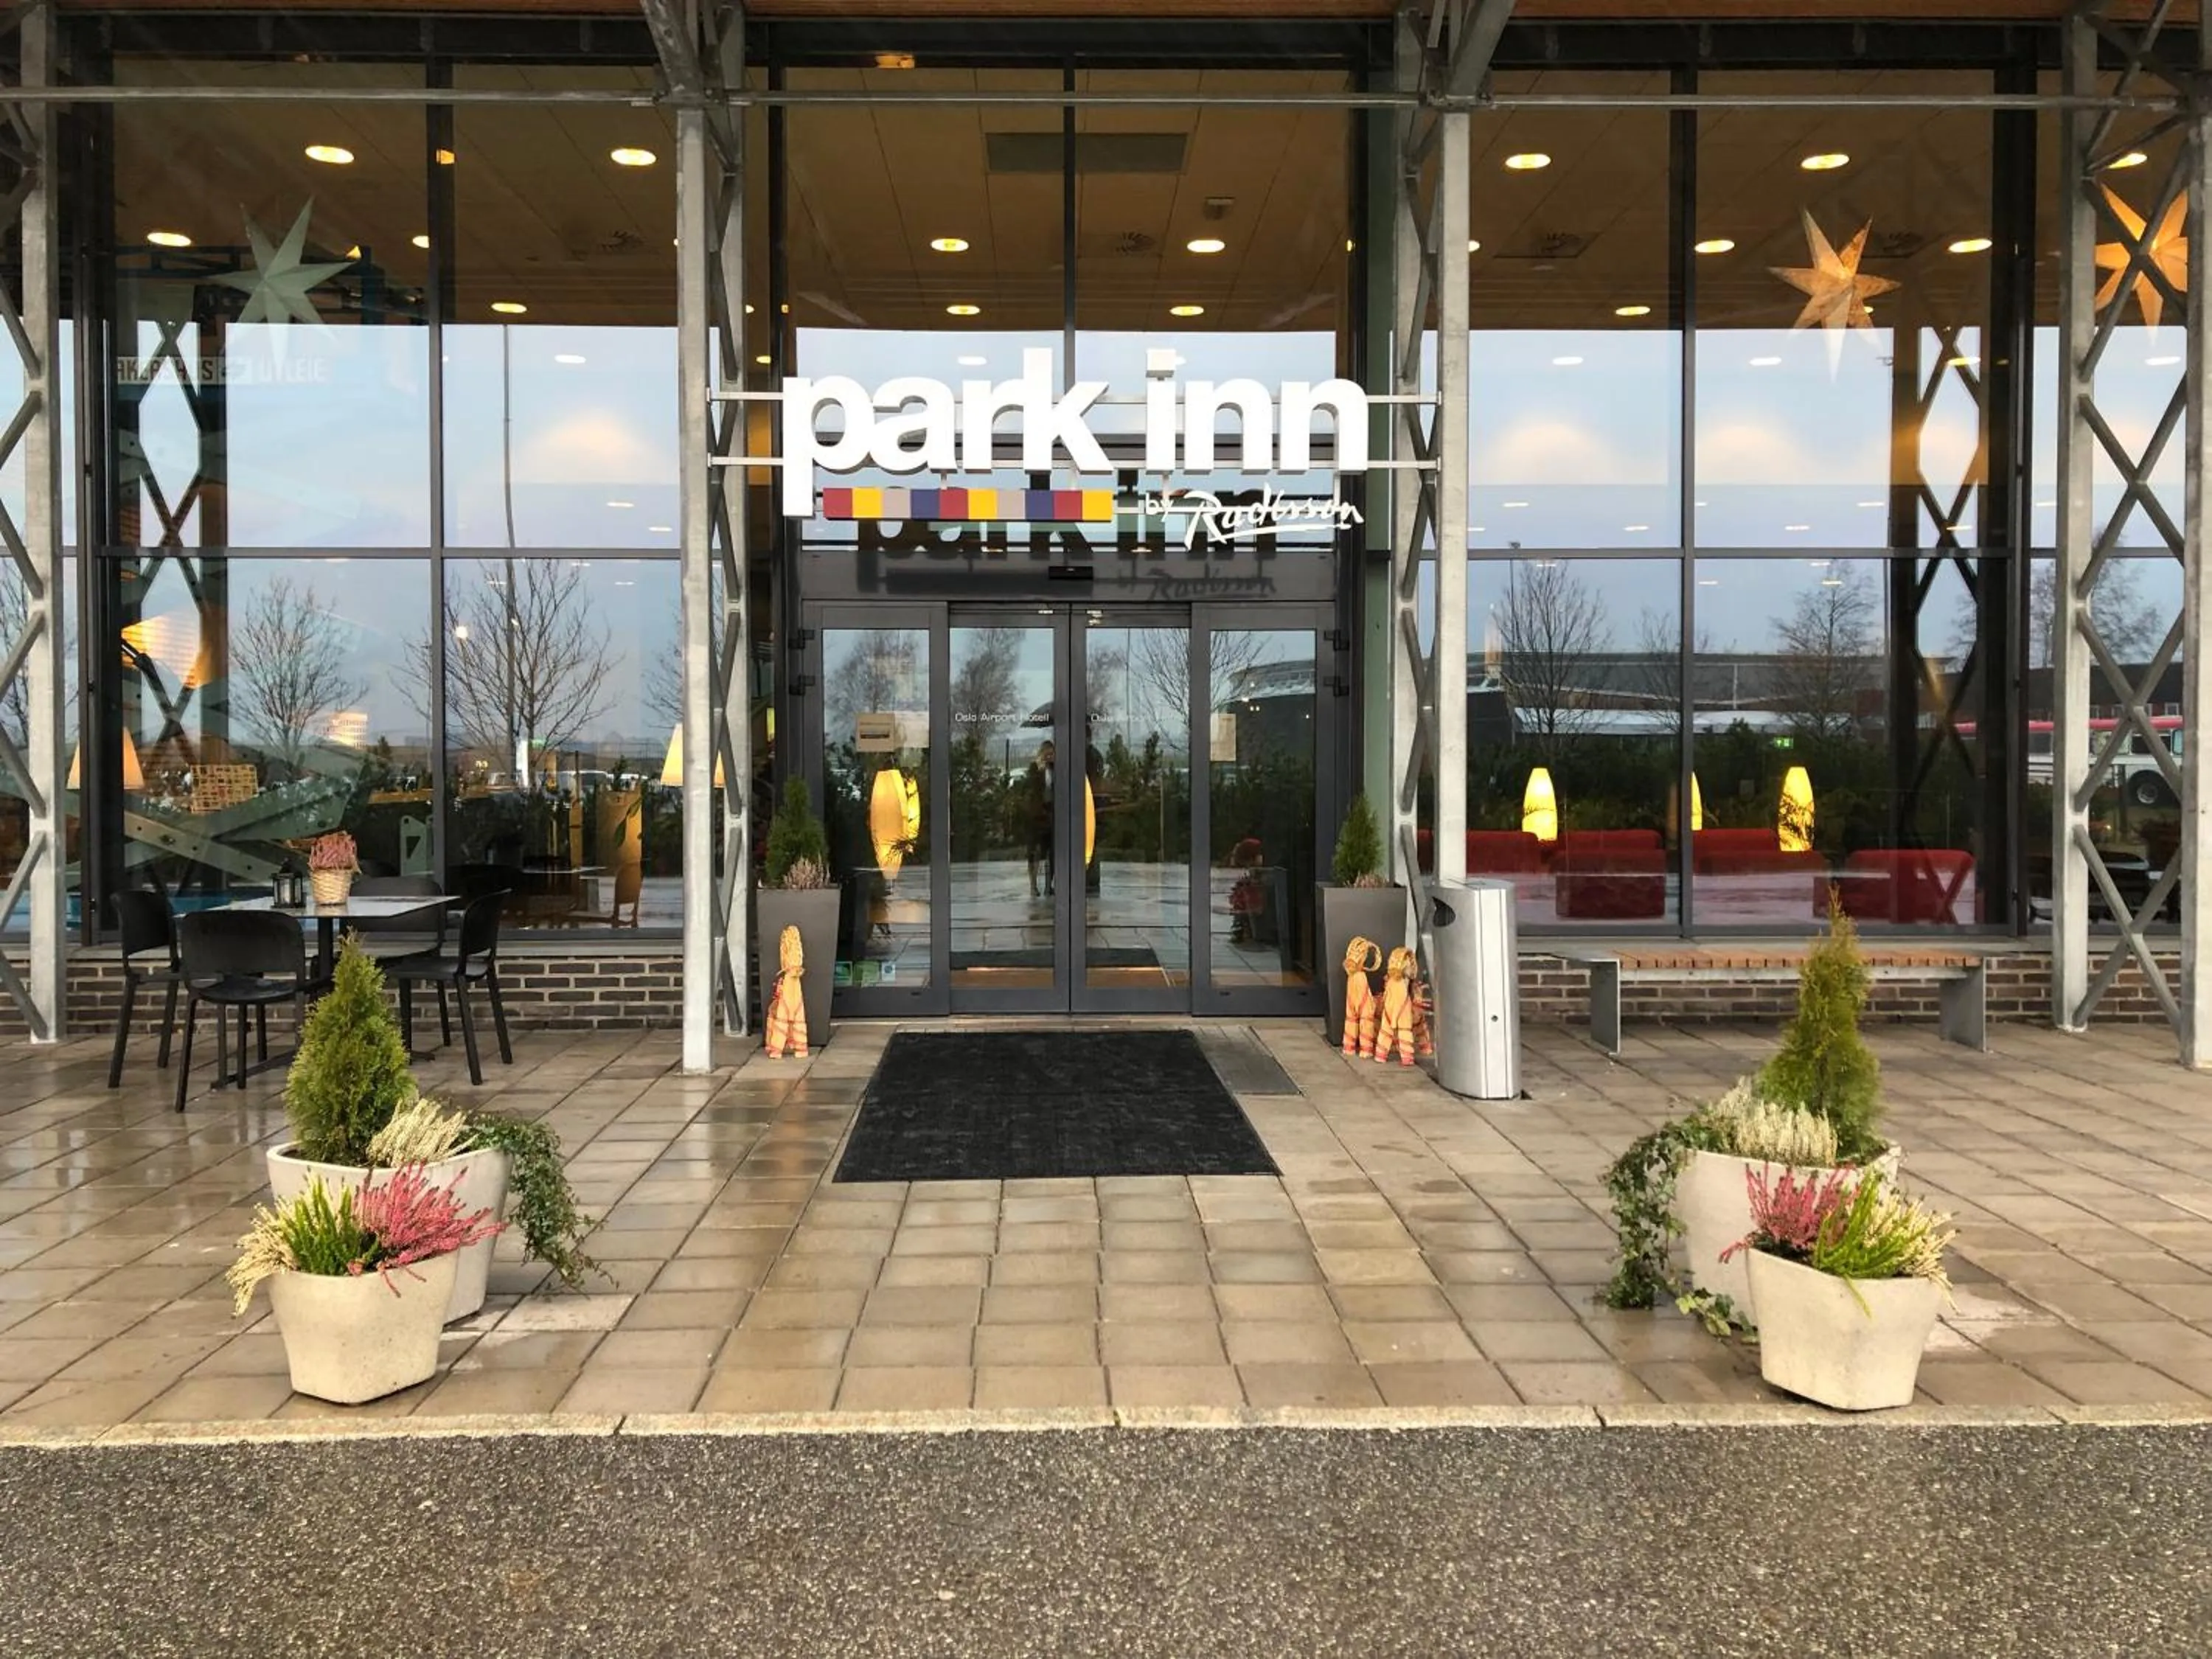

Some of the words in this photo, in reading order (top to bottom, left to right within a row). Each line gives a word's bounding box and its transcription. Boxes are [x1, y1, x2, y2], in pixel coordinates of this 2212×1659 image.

[117, 358, 214, 381] AKRHS
[783, 347, 1115, 518] park
[1145, 348, 1368, 474] inn
[1145, 492, 1175, 523] by
[1183, 482, 1364, 552] Radisson
[955, 712, 977, 722] Oslo
